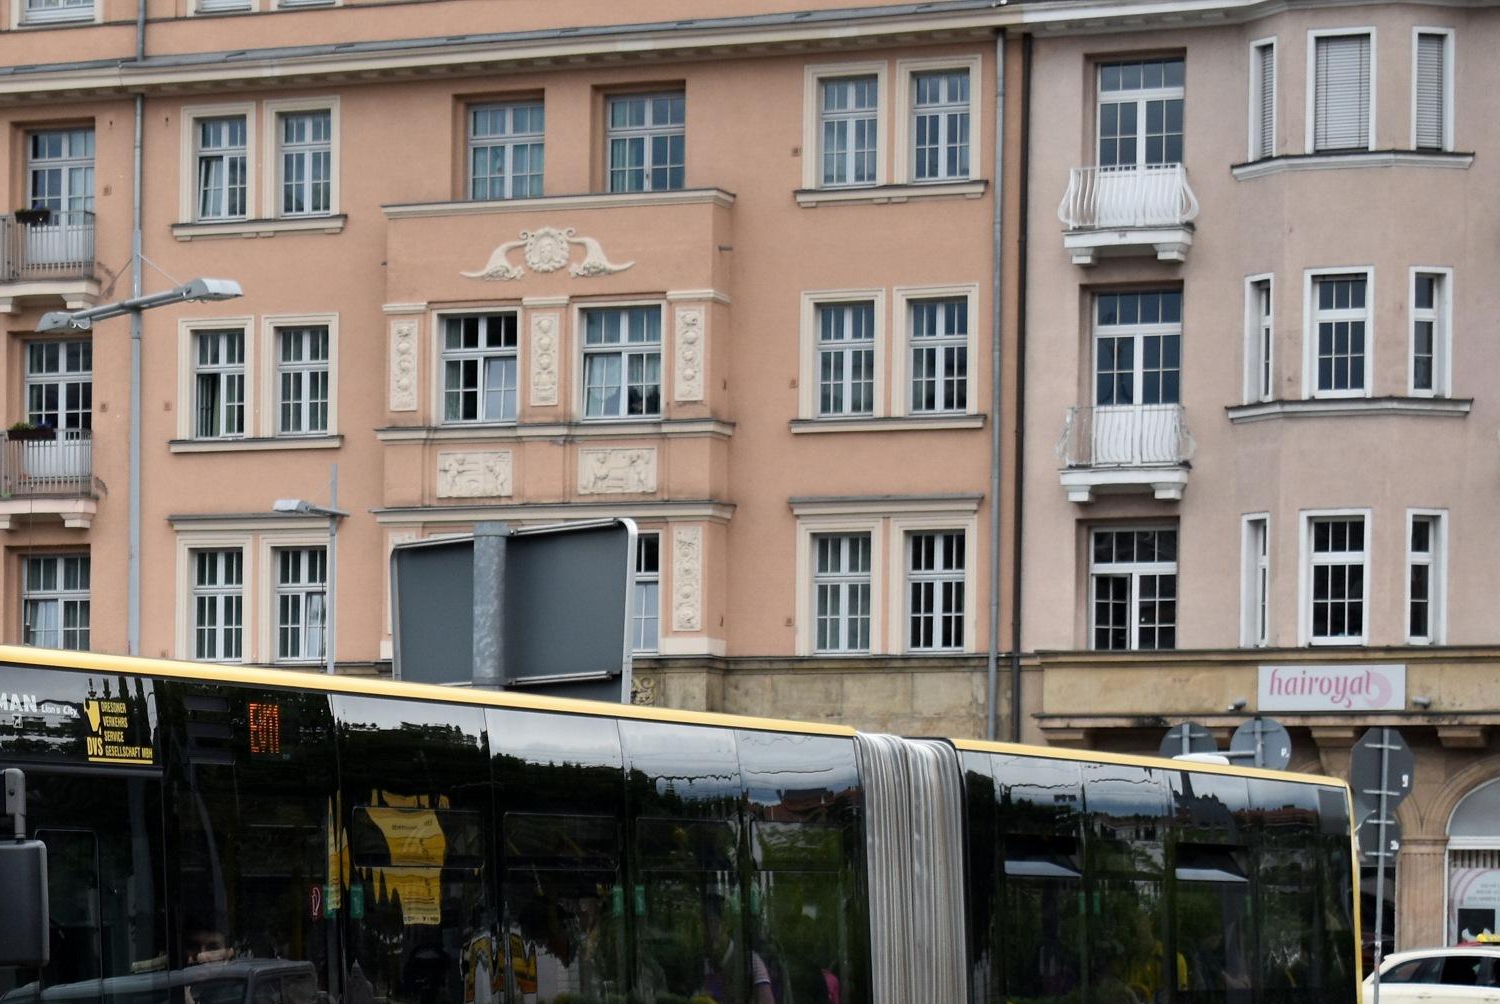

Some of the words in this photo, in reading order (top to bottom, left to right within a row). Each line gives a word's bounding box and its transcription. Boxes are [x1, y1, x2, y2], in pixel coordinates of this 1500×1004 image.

[1269, 668, 1371, 708] hairoyal
[100, 701, 127, 714] DRESDNER
[102, 716, 129, 729] VERKEHRS
[103, 730, 125, 743] SERVICE
[86, 736, 104, 757] DVS
[104, 745, 141, 758] GESELLSCHAFT
